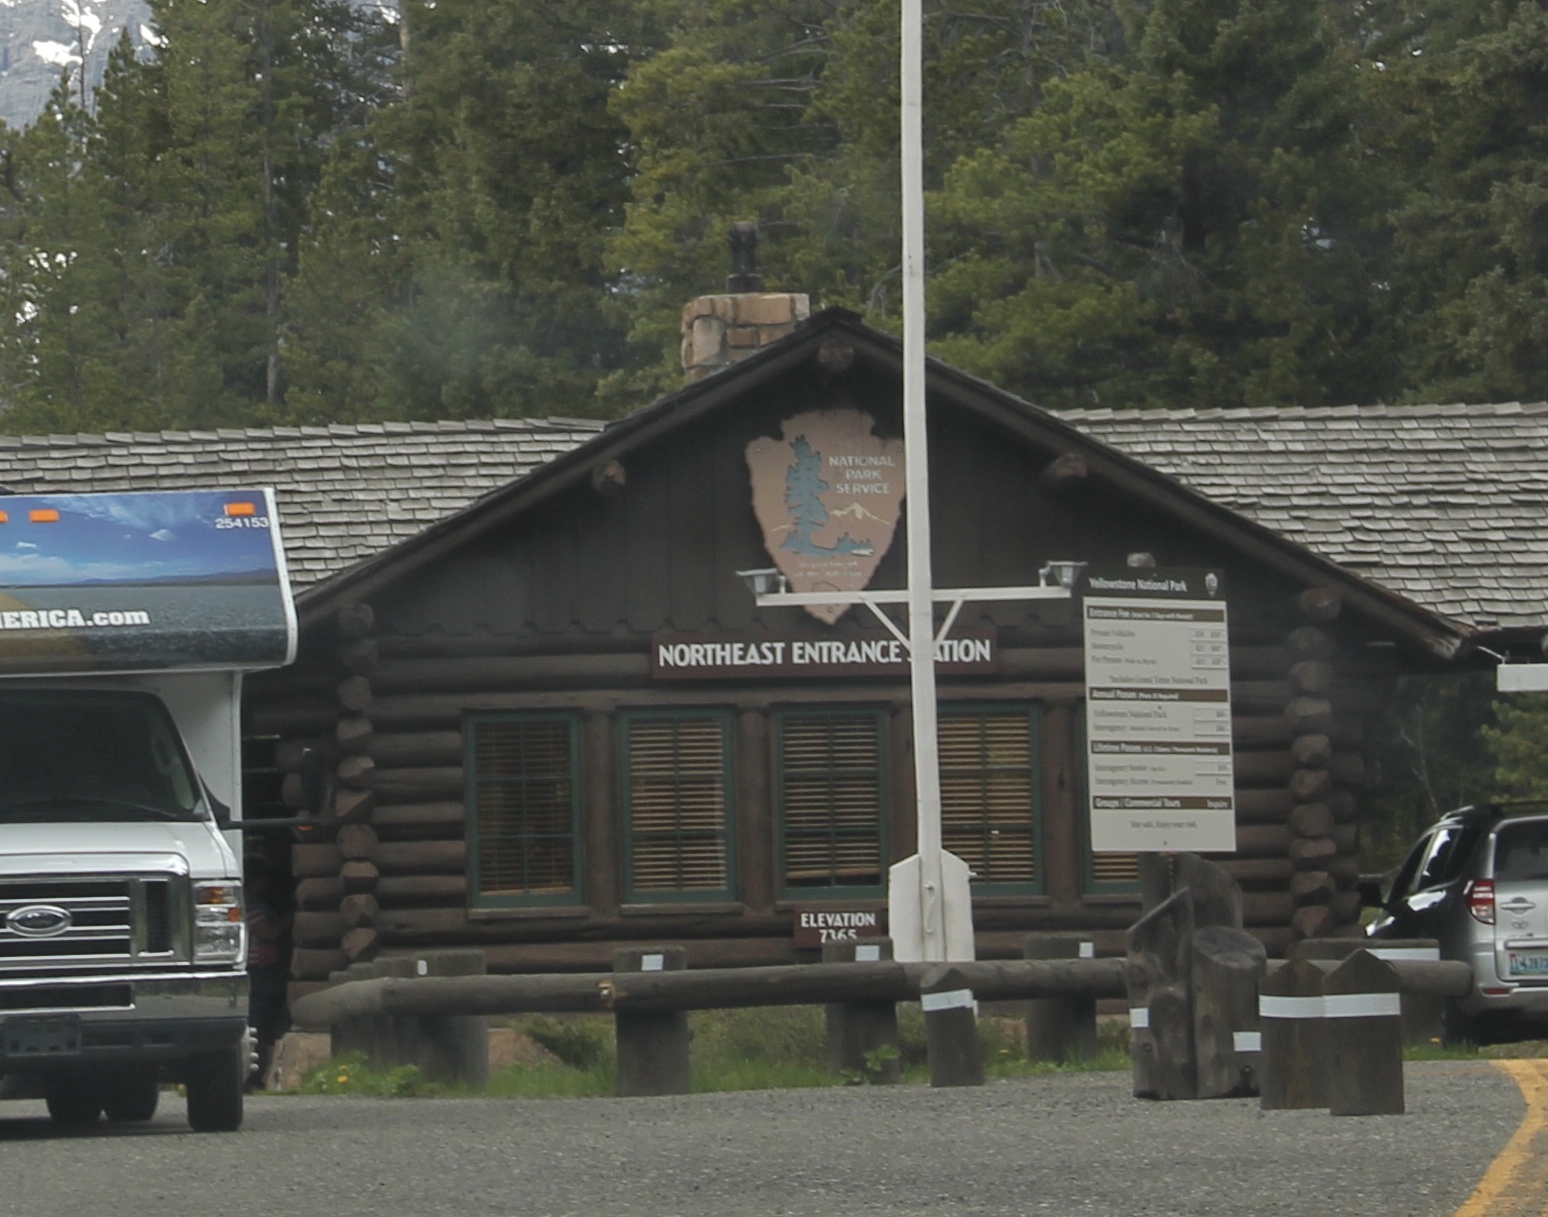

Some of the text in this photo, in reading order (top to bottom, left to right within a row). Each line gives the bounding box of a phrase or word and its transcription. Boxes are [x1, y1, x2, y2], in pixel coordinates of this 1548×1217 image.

[828, 455, 896, 467] NATIONAL
[845, 469, 882, 480] PARK
[836, 483, 891, 494] SERVICE
[215, 515, 269, 529] 254153
[1089, 577, 1188, 592] Yellowstone National Park
[659, 642, 785, 666] NORTHEAST
[792, 640, 901, 664] ENTRANCE
[801, 912, 876, 928] ELEVATION
